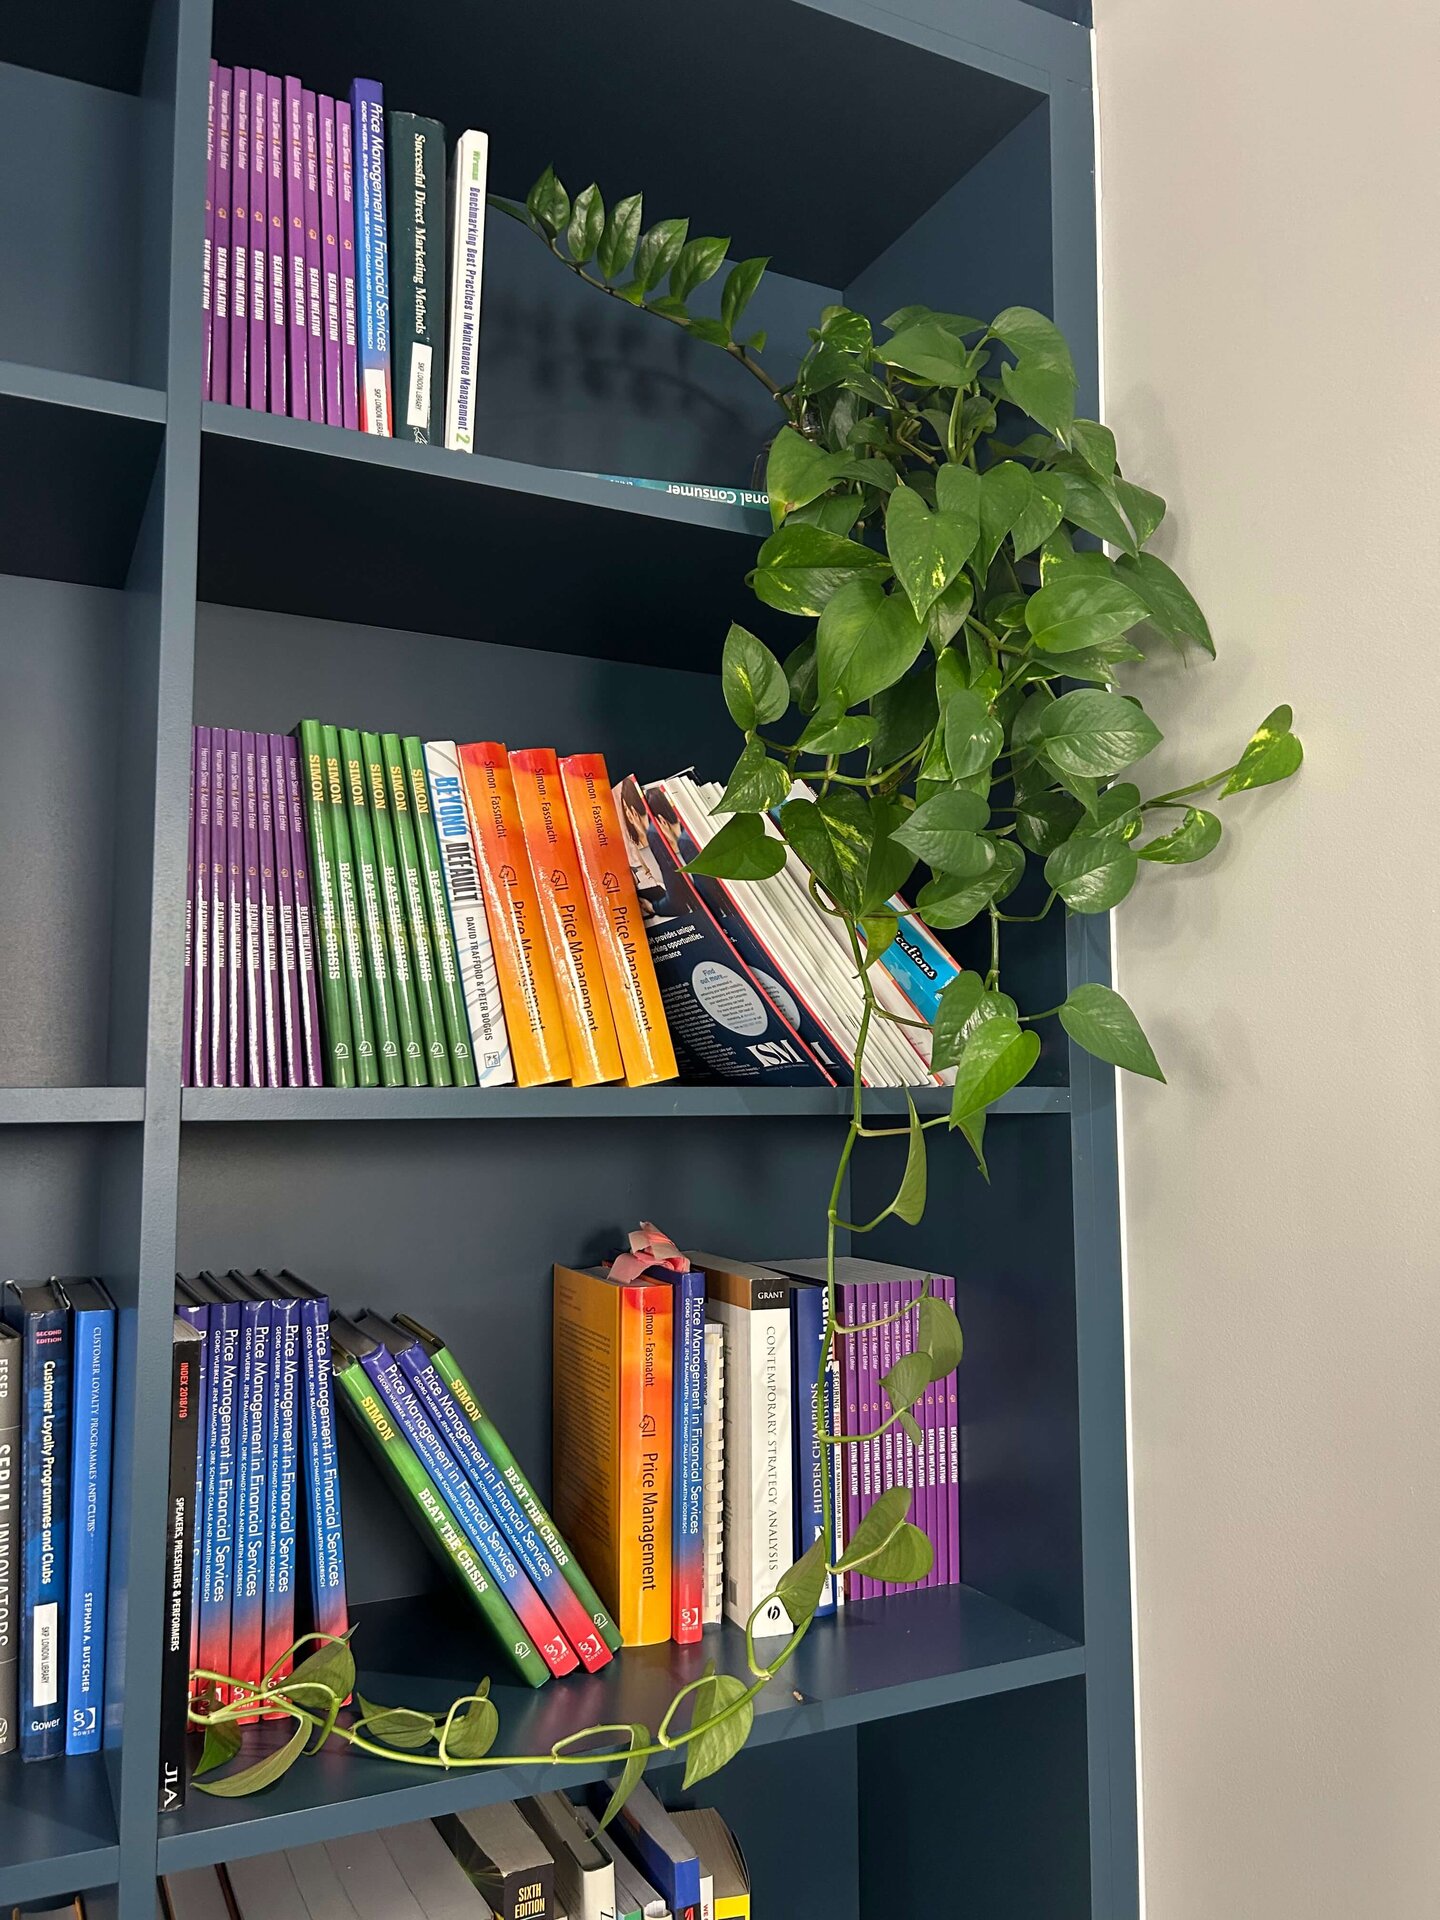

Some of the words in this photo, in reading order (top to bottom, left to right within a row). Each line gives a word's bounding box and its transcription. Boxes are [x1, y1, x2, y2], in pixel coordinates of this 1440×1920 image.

[371, 102, 383, 133] Price
[370, 135, 384, 220] Management
[415, 133, 426, 187] Successful
[415, 190, 426, 224] Direct
[466, 187, 480, 246] Benchmarking
[374, 224, 386, 236] in
[236, 247, 245, 277] BEATING
[295, 256, 303, 287] BEATING
[375, 240, 388, 299] Financial
[413, 226, 426, 284] Marketing
[466, 248, 477, 266] Best
[236, 279, 245, 317] INFLATION
[296, 288, 304, 326] INFLATION
[345, 278, 354, 308] BEATING
[464, 270, 476, 309] Practices
[346, 309, 355, 345] INFLATION
[376, 301, 388, 351] Services
[415, 287, 426, 334] Methods
[464, 312, 474, 320] in
[417, 362, 425, 371] SKP
[461, 322, 474, 375] Maintenance
[415, 391, 423, 410] LIBRARY
[416, 372, 424, 390] LONDON
[458, 378, 470, 430] Management
[456, 433, 470, 444] 2
[666, 484, 737, 503] Consumer
[290, 758, 298, 779] Hermann
[327, 758, 342, 803] SIMON
[370, 764, 385, 809] SIMON
[390, 767, 407, 810] SIMON
[411, 769, 428, 813] SIMON
[434, 777, 467, 836] BEYOND
[484, 761, 496, 788] Simon
[491, 796, 507, 838] Fassnacht
[534, 768, 548, 795] Simon
[541, 802, 558, 843] Fassnacht
[584, 772, 598, 799] Simon
[592, 806, 609, 846] Fassnacht
[445, 842, 478, 902] DEFAULT
[301, 907, 310, 934] BEATING
[466, 916, 476, 939] DAVID
[655, 930, 677, 943] provides
[677, 924, 695, 935] unique
[303, 937, 313, 970] INFLATION
[469, 942, 482, 979] TRAFFORD
[560, 905, 580, 937] Price
[571, 942, 598, 1032] Management
[612, 907, 633, 938] Price
[623, 943, 652, 1032] Management
[896, 931, 935, 978] cations
[478, 988, 488, 1011] PETER
[482, 1014, 493, 1040] BOGGIS
[745, 1040, 805, 1067] ISM
[693, 1298, 703, 1325] Price
[757, 1291, 784, 1299] GRANT
[285, 1325, 298, 1356] Price
[316, 1324, 329, 1356] Price
[645, 1306, 655, 1335] Simon
[92, 1327, 101, 1374] CUSTOMER
[645, 1343, 655, 1387] Fassnacht
[690, 1329, 703, 1409] Management
[43, 1361, 55, 1413] Customer
[180, 1362, 189, 1385] INDEX
[766, 1326, 778, 1436] CONTEMPORARY
[90, 1377, 100, 1414] LOYALTY
[179, 1387, 188, 1418] 2018/19
[280, 1360, 297, 1450] Management
[317, 1359, 332, 1448] Management
[452, 1379, 482, 1421] SIMON
[41, 1415, 55, 1455] Loyalty
[361, 1396, 394, 1441] SIMON
[692, 1413, 702, 1424] in
[88, 1418, 99, 1479] PROGRAMMES
[283, 1455, 295, 1468] in
[323, 1453, 336, 1466] in
[691, 1428, 702, 1481] Financial
[0, 1445, 10, 1511] SERIAL
[421, 1366, 443, 1396] Price
[438, 1394, 489, 1470] Management
[484, 1468, 496, 1484] in
[492, 1481, 529, 1533] Financial
[522, 1530, 553, 1577] Services
[642, 1453, 658, 1488] Price
[767, 1440, 778, 1504] STRATEGY
[814, 1463, 822, 1513] HIDDEN
[41, 1457, 55, 1528] Programmes
[88, 1482, 96, 1503] AND
[280, 1471, 295, 1533] Financial
[324, 1469, 340, 1529] Financial
[690, 1486, 701, 1534] Services
[87, 1504, 96, 1532] CLUBS
[174, 1497, 184, 1538] SPEAKERS,
[504, 1466, 529, 1501] BEAT
[525, 1498, 545, 1526] THE
[540, 1523, 569, 1566] CRISIS
[43, 1530, 54, 1551] and
[327, 1532, 341, 1587] Services
[418, 1488, 444, 1526] BEAT
[440, 1523, 462, 1550] THE
[458, 1545, 489, 1593] CRISIS
[639, 1493, 658, 1591] Management
[768, 1510, 778, 1570] ANALYSIS
[0, 1523, 10, 1646] INNOVATORS
[42, 1553, 54, 1584] Clubs
[173, 1540, 183, 1588] PRESENTERS
[279, 1538, 294, 1592] Services
[42, 1626, 50, 1638] SKP
[84, 1593, 92, 1632] STEPHAN
[171, 1598, 181, 1651] PERFORMERS
[41, 1639, 50, 1661] LONDON
[83, 1635, 91, 1644] A.
[41, 1662, 50, 1684] LIBRARY
[81, 1646, 91, 1692] BUTSCHER
[31, 1718, 60, 1730] Gower
[164, 1762, 178, 1808] JLA
[515, 1898, 545, 1919] EDITION
[519, 1883, 542, 1902] SIXTH
